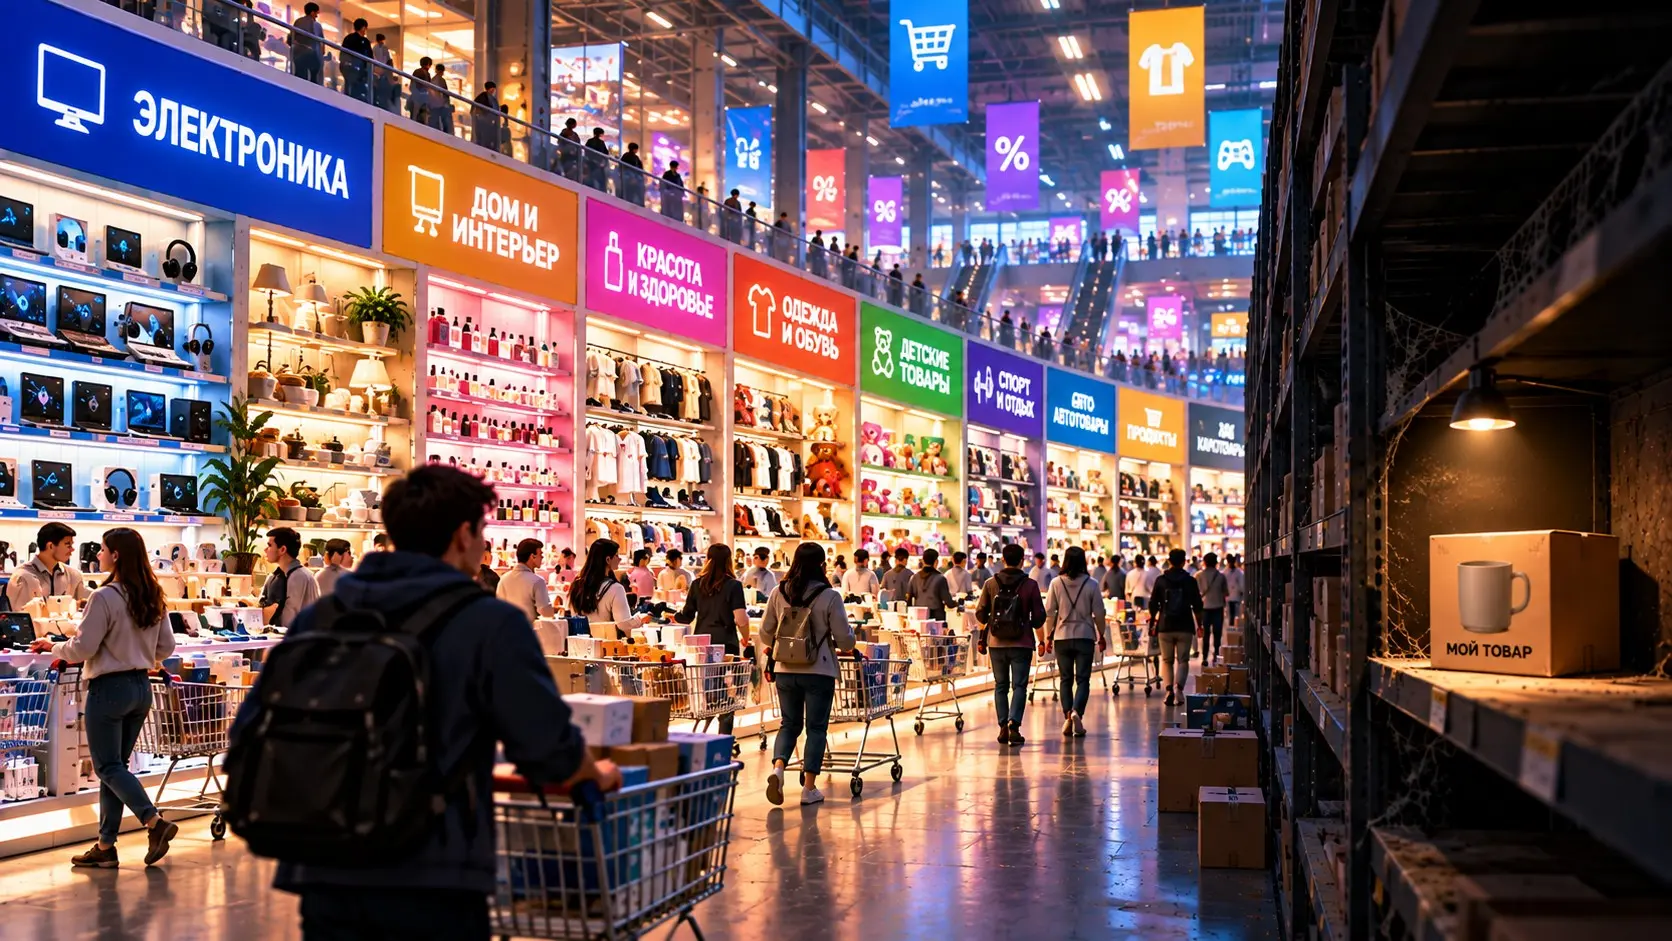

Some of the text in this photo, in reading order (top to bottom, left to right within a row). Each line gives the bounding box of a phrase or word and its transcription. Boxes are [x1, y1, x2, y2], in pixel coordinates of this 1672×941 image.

[132, 89, 350, 200] ЭЛЕКТРОНИКА
[471, 186, 538, 233] ДОМ И
[452, 218, 560, 270] ИНТЕРЬЕР
[636, 242, 703, 287] КРАСОТА
[627, 269, 714, 320] И ЗДОРОВЬЕ
[782, 295, 839, 334] ОДЕЖДА
[782, 321, 840, 360] И ОБУВЬ
[899, 337, 950, 369] ДЕТСКИЕ
[899, 362, 951, 395] ТОВАРЫ
[998, 370, 1031, 396] СПОРТ
[996, 390, 1035, 419] И ОТДЫХ
[1446, 640, 1533, 659] МОЙ ТОВАР
